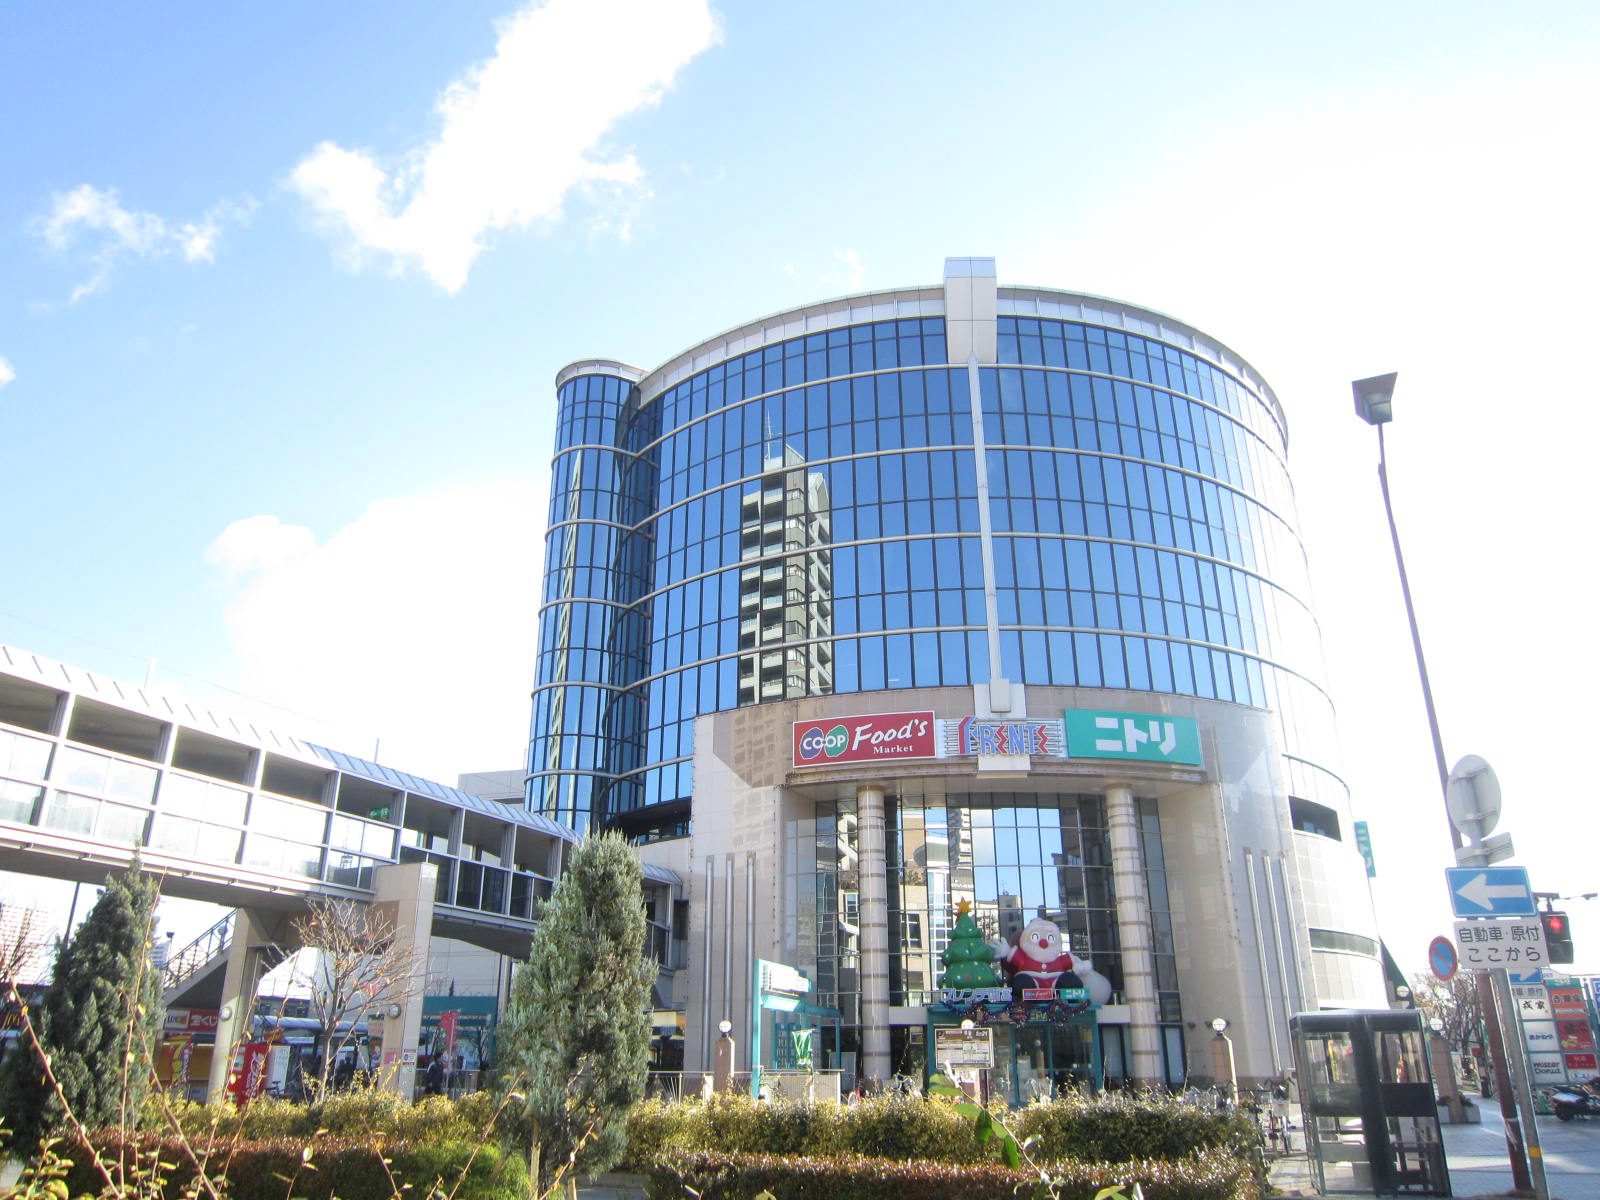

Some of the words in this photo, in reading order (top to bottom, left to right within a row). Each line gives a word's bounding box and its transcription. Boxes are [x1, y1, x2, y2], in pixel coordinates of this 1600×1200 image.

[803, 735, 847, 751] COOP
[852, 718, 929, 751] Food's
[1095, 716, 1177, 756] ニトリ
[873, 744, 914, 755] Market
[1468, 946, 1541, 962] ここから
